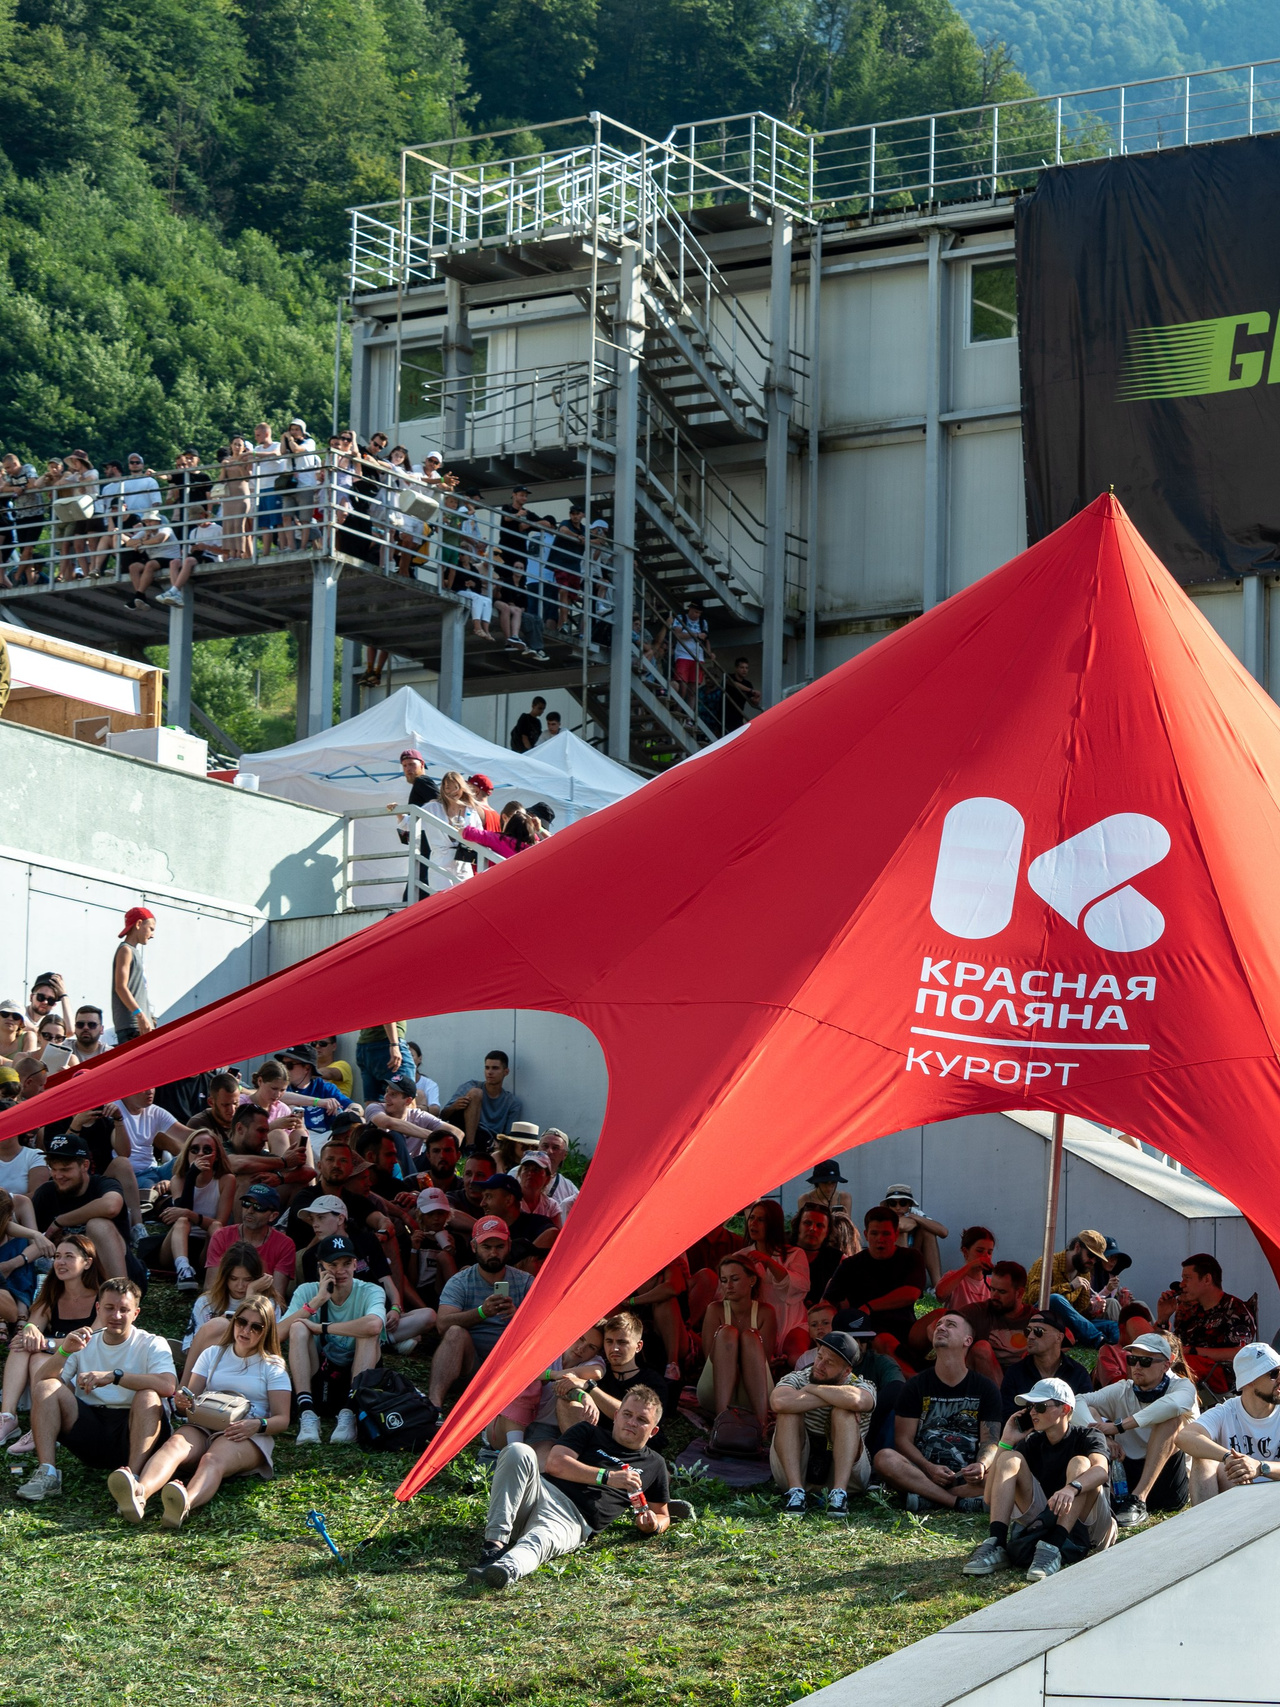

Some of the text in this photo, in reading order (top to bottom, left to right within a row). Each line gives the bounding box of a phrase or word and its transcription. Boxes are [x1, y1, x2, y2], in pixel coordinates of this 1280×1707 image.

[920, 957, 1157, 1001] КРАСНАЯ
[915, 987, 1129, 1030] ПОЛЯНА
[905, 1047, 1080, 1086] КУРОРТ
